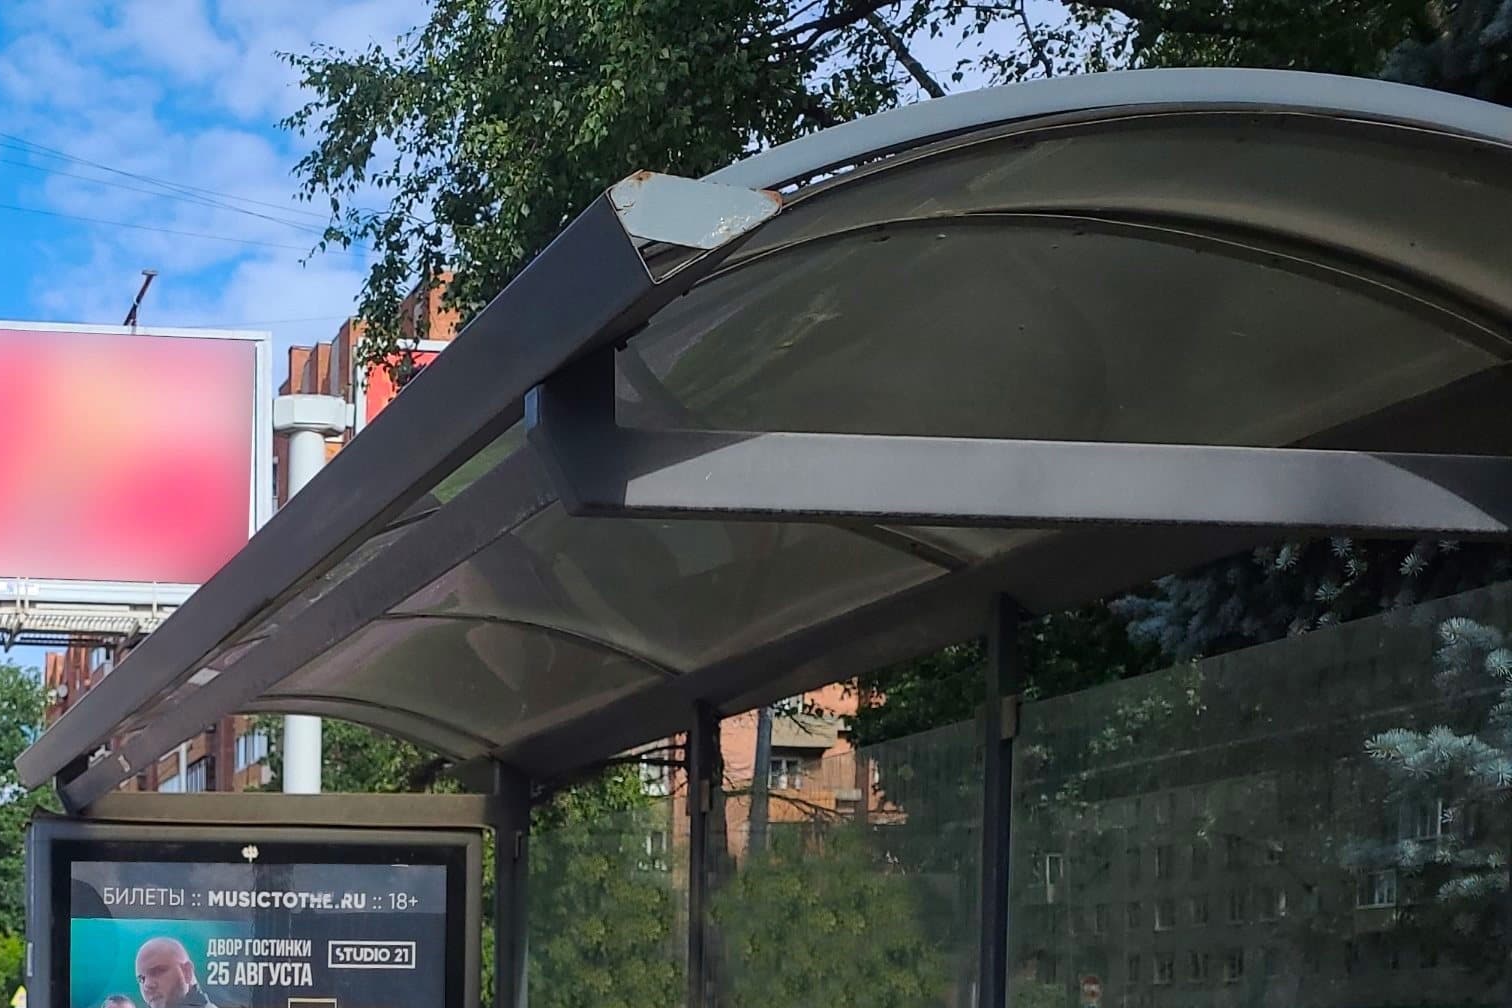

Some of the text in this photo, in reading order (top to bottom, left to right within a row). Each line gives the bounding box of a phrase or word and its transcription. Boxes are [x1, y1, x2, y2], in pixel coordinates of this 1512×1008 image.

[103, 887, 185, 907] БИЛЕТЫ
[208, 890, 367, 910] MUSICTOTHE.RU
[388, 893, 419, 911] 18+
[207, 938, 312, 958] ДВОР ГОСТИНКИ
[335, 947, 410, 963] STUDIO 21
[207, 961, 313, 986] 25 АВГУСТА
